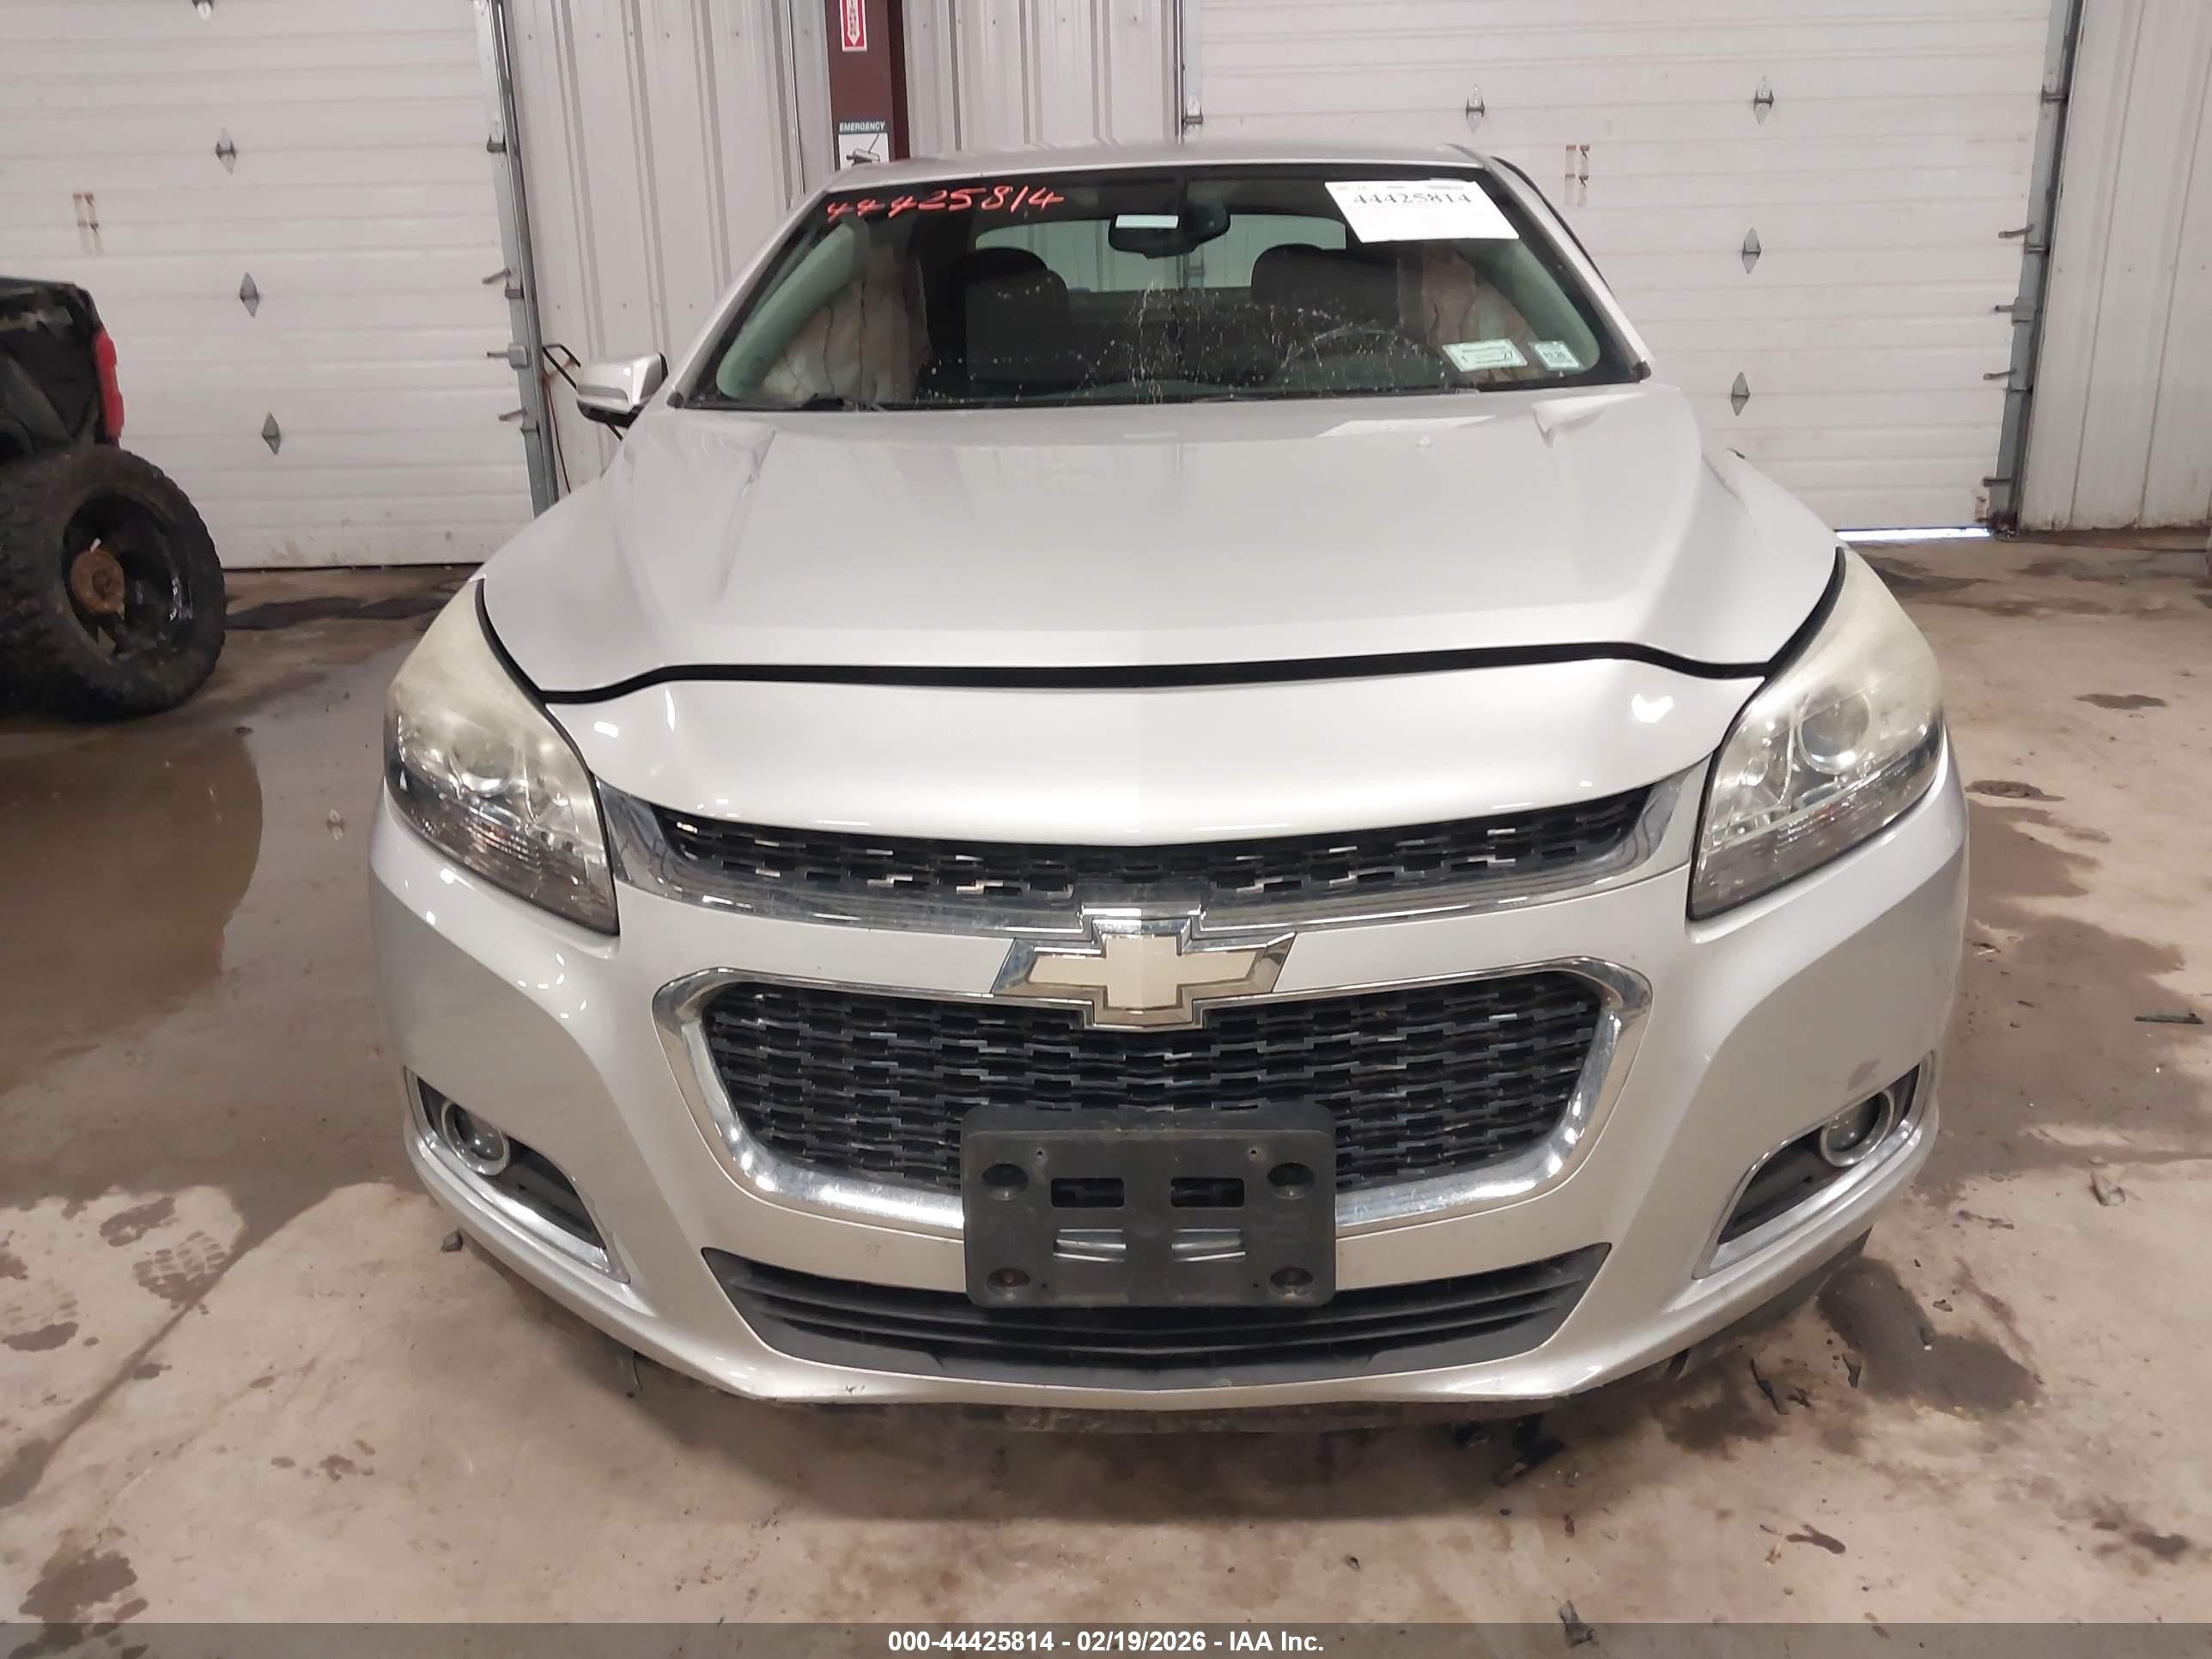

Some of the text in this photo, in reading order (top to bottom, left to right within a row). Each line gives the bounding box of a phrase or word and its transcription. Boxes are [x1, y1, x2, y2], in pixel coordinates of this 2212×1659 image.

[839, 120, 886, 131] EMERGENCY
[827, 185, 1065, 222] 44425814
[1353, 192, 1473, 204] 44425814
